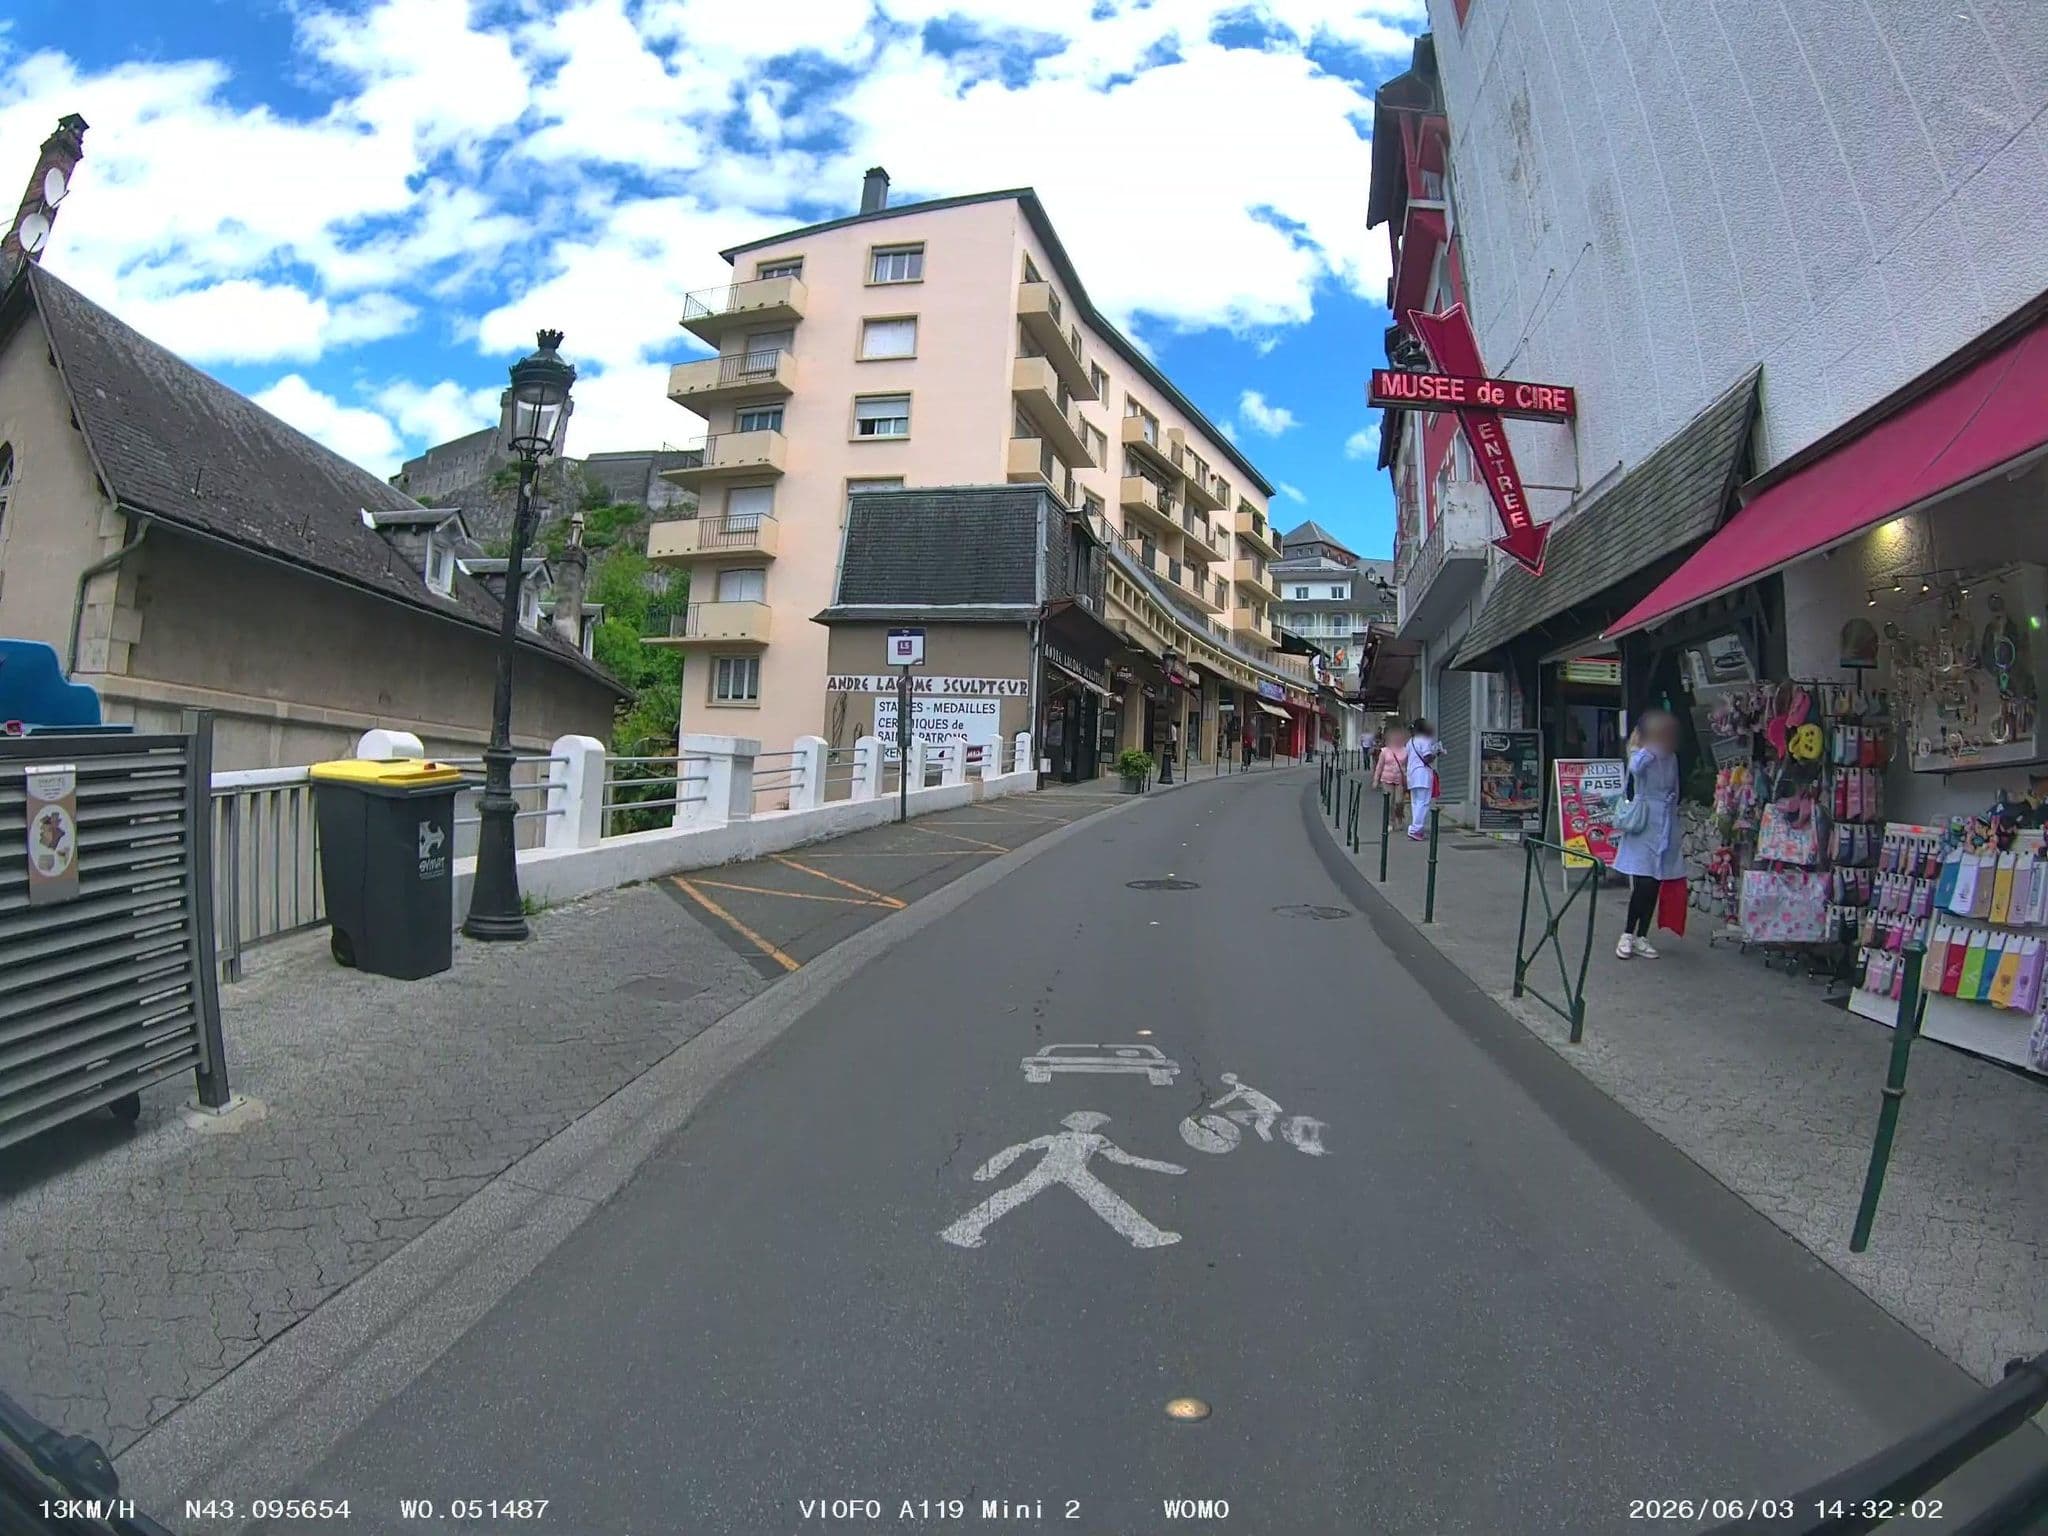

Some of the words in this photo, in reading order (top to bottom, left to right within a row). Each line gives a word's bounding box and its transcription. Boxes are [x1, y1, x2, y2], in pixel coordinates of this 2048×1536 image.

[1381, 373, 1466, 401] MUSEE
[1476, 381, 1505, 405] de
[1515, 385, 1568, 412] CIRE
[1477, 422, 1527, 529] ENTREE
[827, 676, 869, 691] ANDRE
[943, 678, 1028, 695] SCULPTEUR
[879, 701, 923, 713] STAES
[933, 702, 996, 715] MEDAILLES
[878, 717, 949, 730] CERIQUES
[951, 719, 964, 730] de
[1584, 779, 1622, 791] PASS
